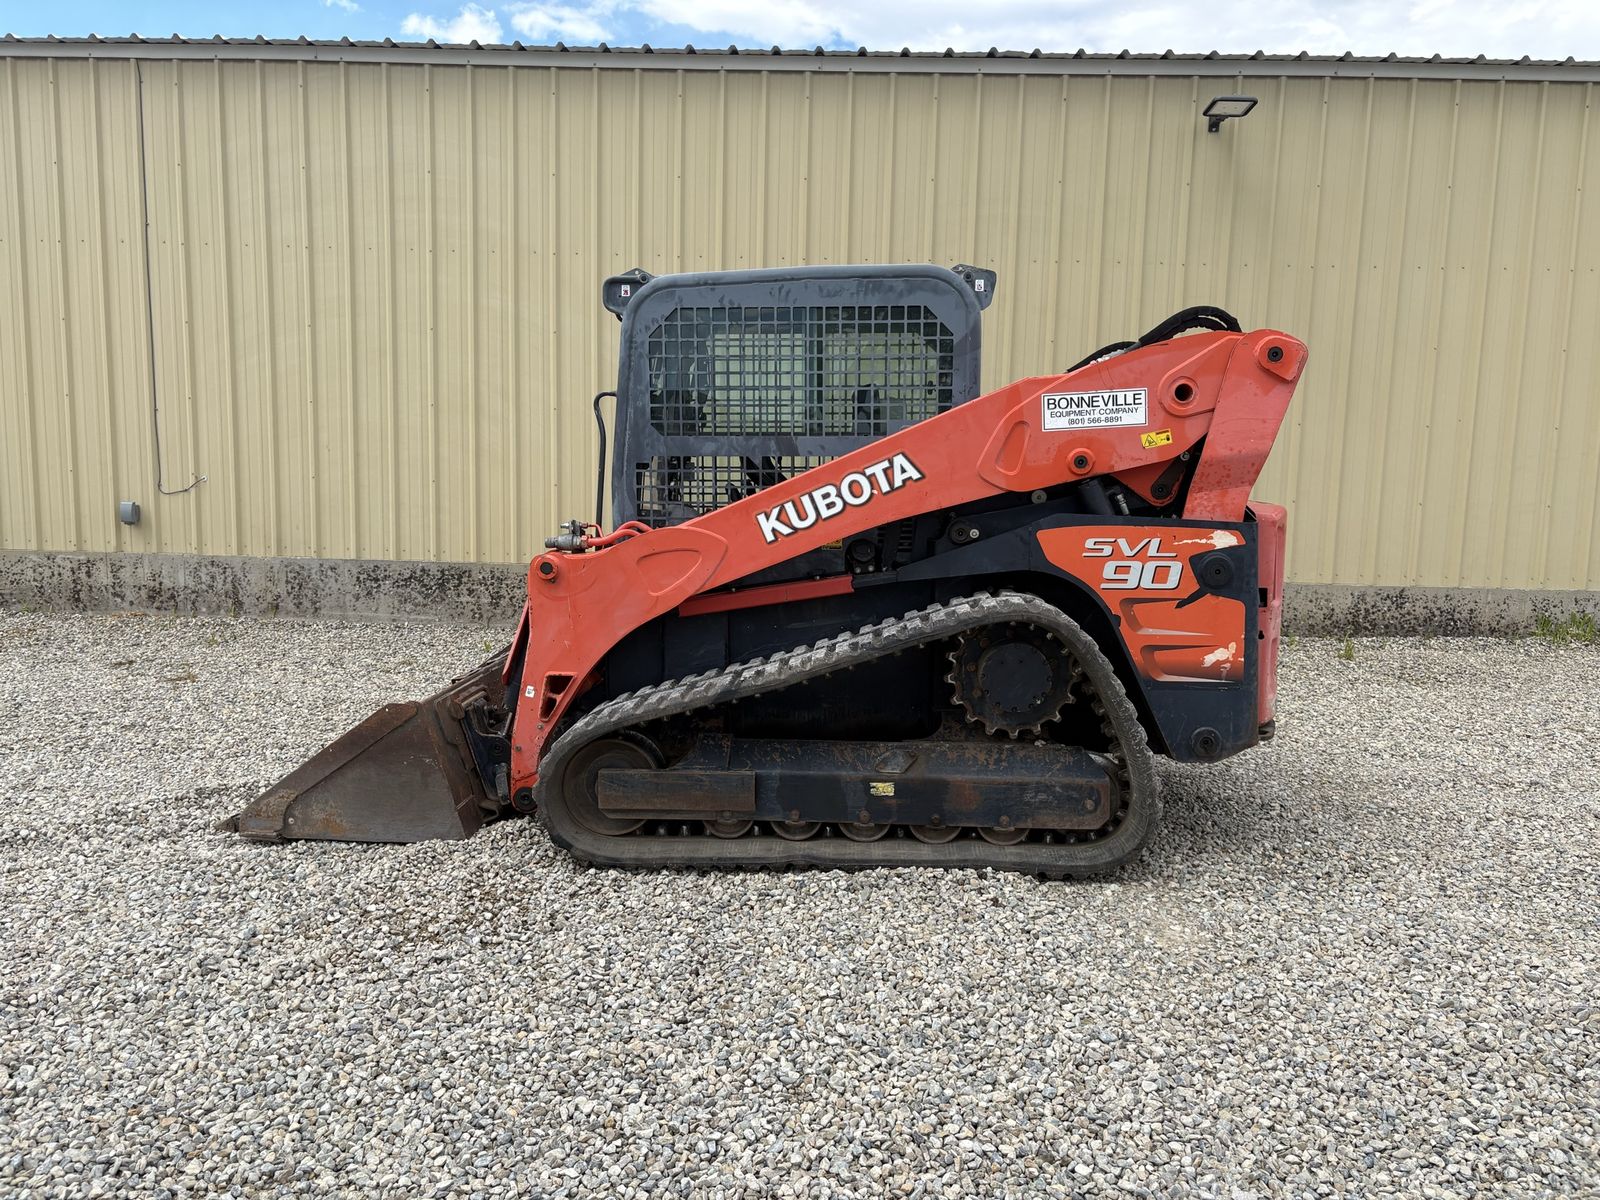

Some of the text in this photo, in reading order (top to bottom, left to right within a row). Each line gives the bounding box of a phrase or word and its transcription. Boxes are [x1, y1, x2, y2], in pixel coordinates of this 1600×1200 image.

[1047, 393, 1142, 410] BONNEVILLE
[1050, 407, 1139, 418] EQUIPMENT COMPANY
[1068, 416, 1122, 426] (801) 566-8891
[756, 452, 924, 543] KUBOTA
[1082, 538, 1177, 557] SVL
[1100, 560, 1183, 589] 90
